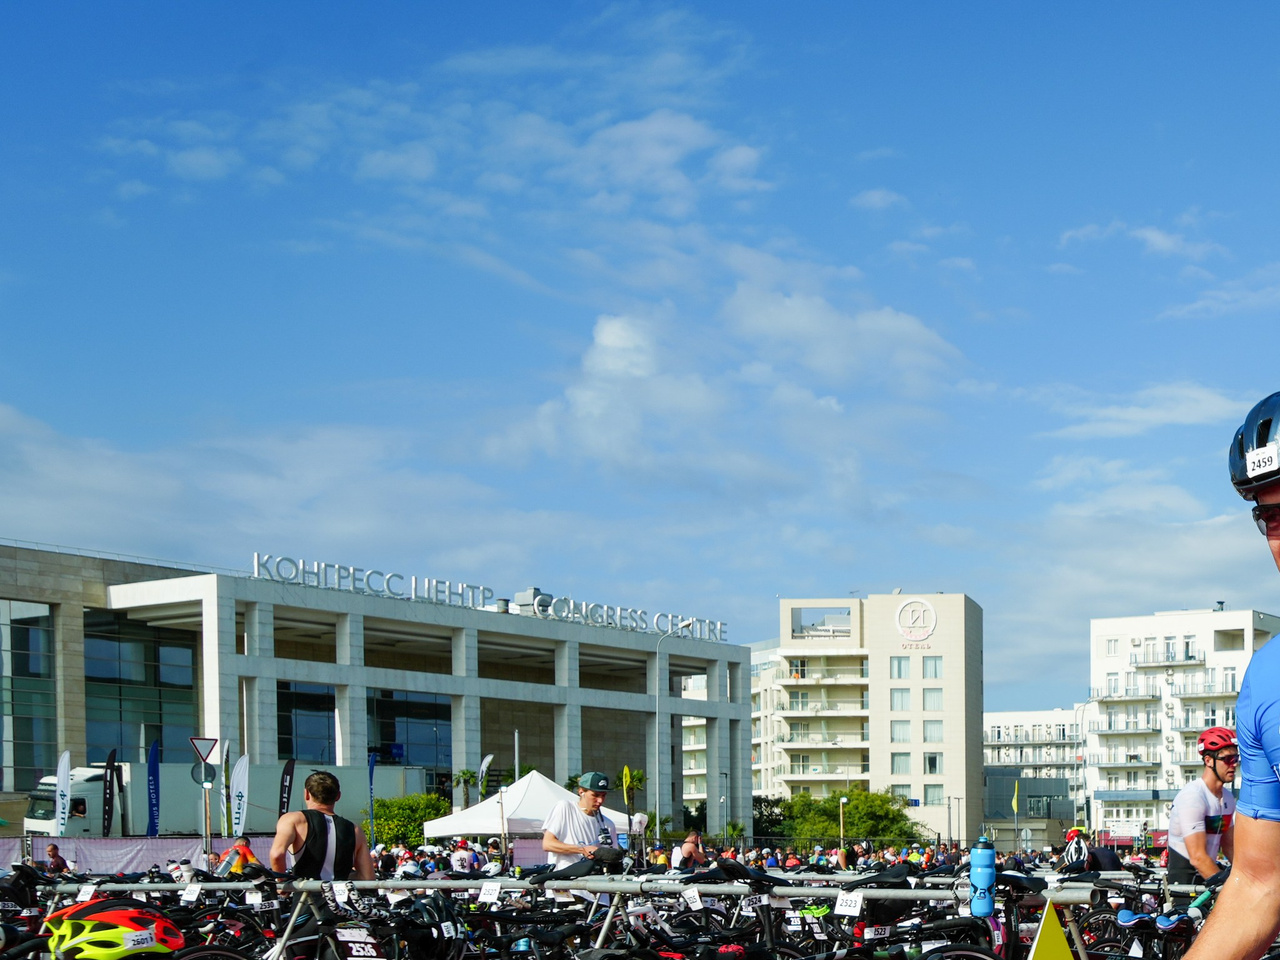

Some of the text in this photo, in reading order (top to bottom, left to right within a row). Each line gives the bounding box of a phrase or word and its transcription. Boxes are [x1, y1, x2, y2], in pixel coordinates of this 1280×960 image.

[1251, 455, 1273, 471] 2459
[253, 552, 494, 608] КОНГРЕСС ЦЕНТР
[533, 594, 728, 642] CONGRESS CENTRE
[259, 901, 275, 909] 2530
[747, 895, 762, 906] 2524
[839, 898, 858, 908] 2523
